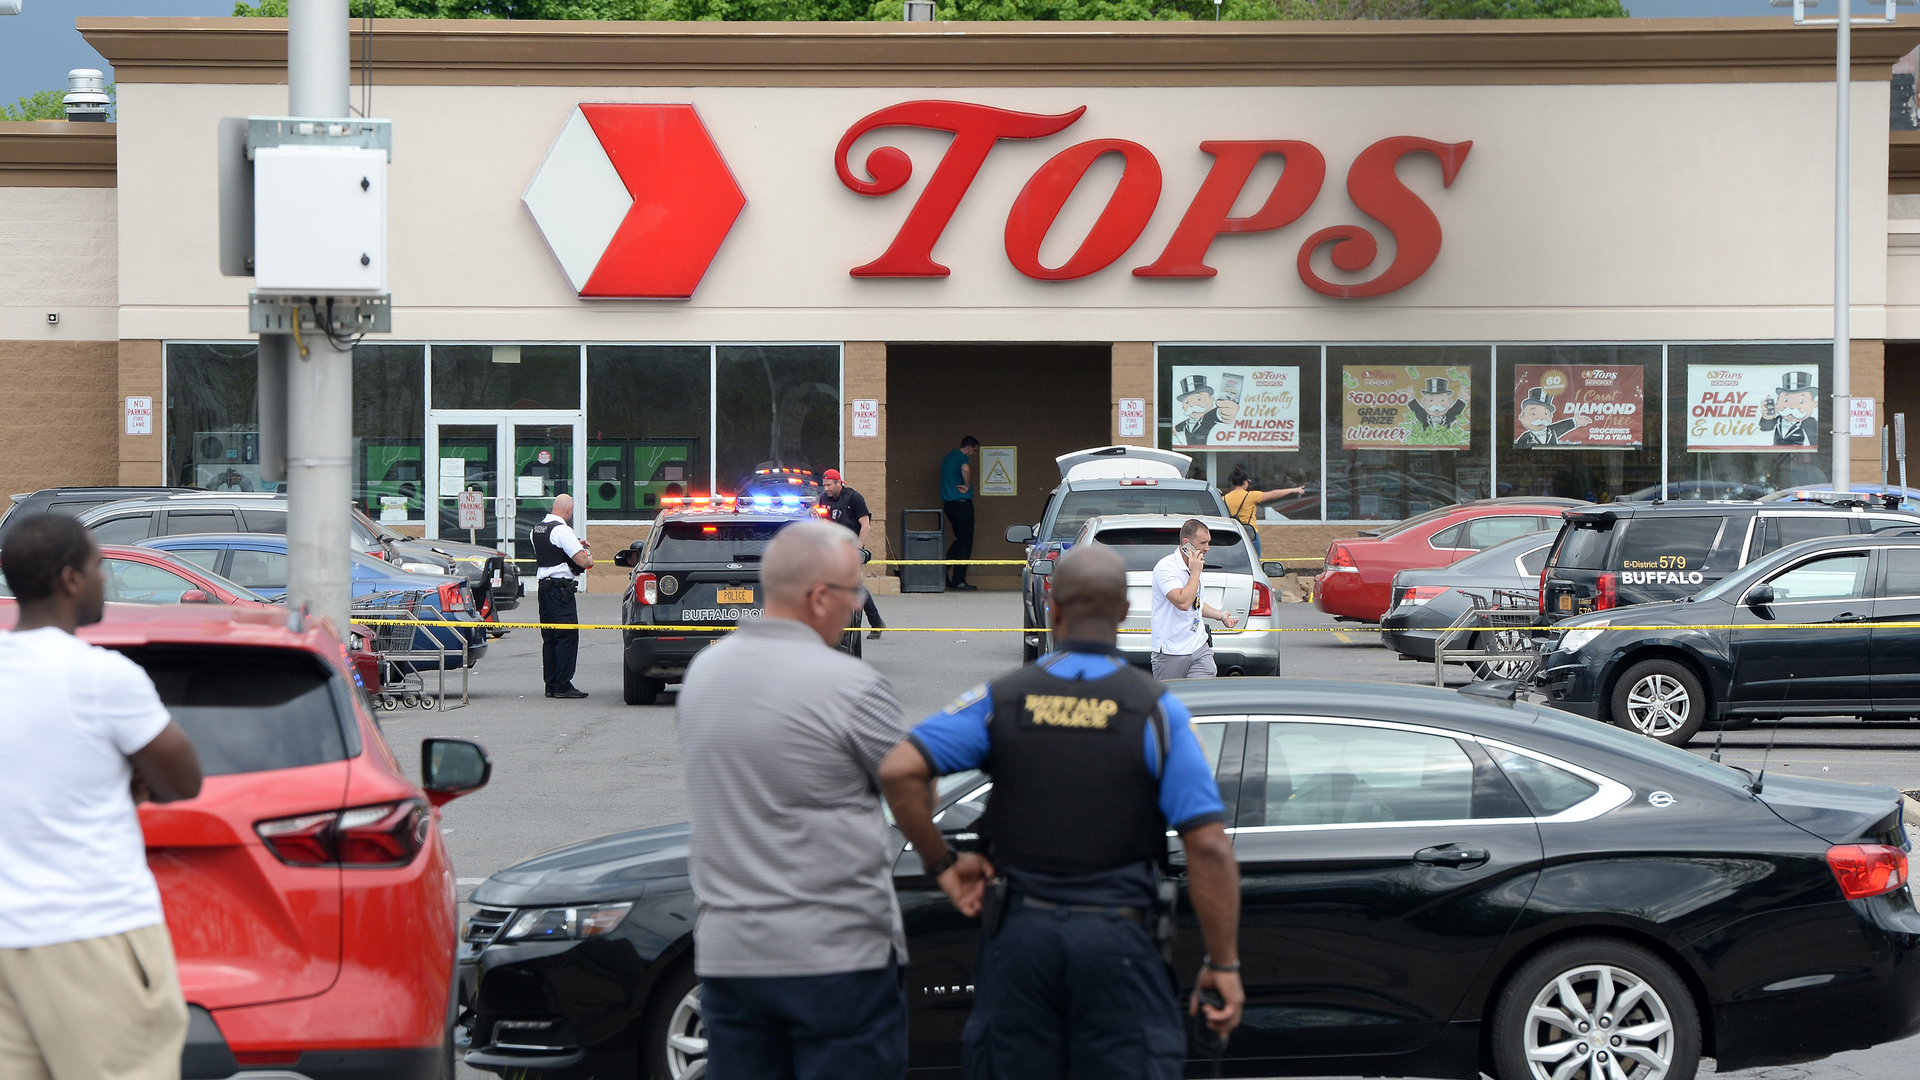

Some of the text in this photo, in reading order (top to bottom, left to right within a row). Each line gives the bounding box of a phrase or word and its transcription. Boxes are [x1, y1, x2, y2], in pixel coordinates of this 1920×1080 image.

[1546, 376, 1561, 386] 60
[1348, 391, 1409, 407] $60,000
[1701, 391, 1748, 404] PLAY
[133, 400, 144, 408] NO
[860, 402, 870, 410] NO
[1127, 402, 1137, 410] NO
[1563, 402, 1636, 415] DIAMOND
[1856, 401, 1867, 409] NO
[127, 408, 151, 416] PARKING
[854, 410, 877, 419] PARKING
[1121, 410, 1144, 418] PARKING
[1357, 407, 1398, 416] GRAND
[1691, 405, 1759, 418] ONLINE
[1850, 410, 1874, 418] PARKING
[1233, 419, 1295, 430] MILLIONS
[1360, 416, 1395, 425] PRIZE
[1215, 430, 1295, 442] OF PRIZES!
[1589, 427, 1631, 435] GROCERIES
[465, 495, 476, 503] NO
[1623, 555, 1687, 569] E-District 579
[1621, 571, 1704, 585] BUFFALO
[723, 591, 746, 601] POLICE
[682, 608, 765, 621] BUFFALO POL
[1024, 694, 1118, 717] BUFFALO
[1031, 708, 1108, 729] POLICE
